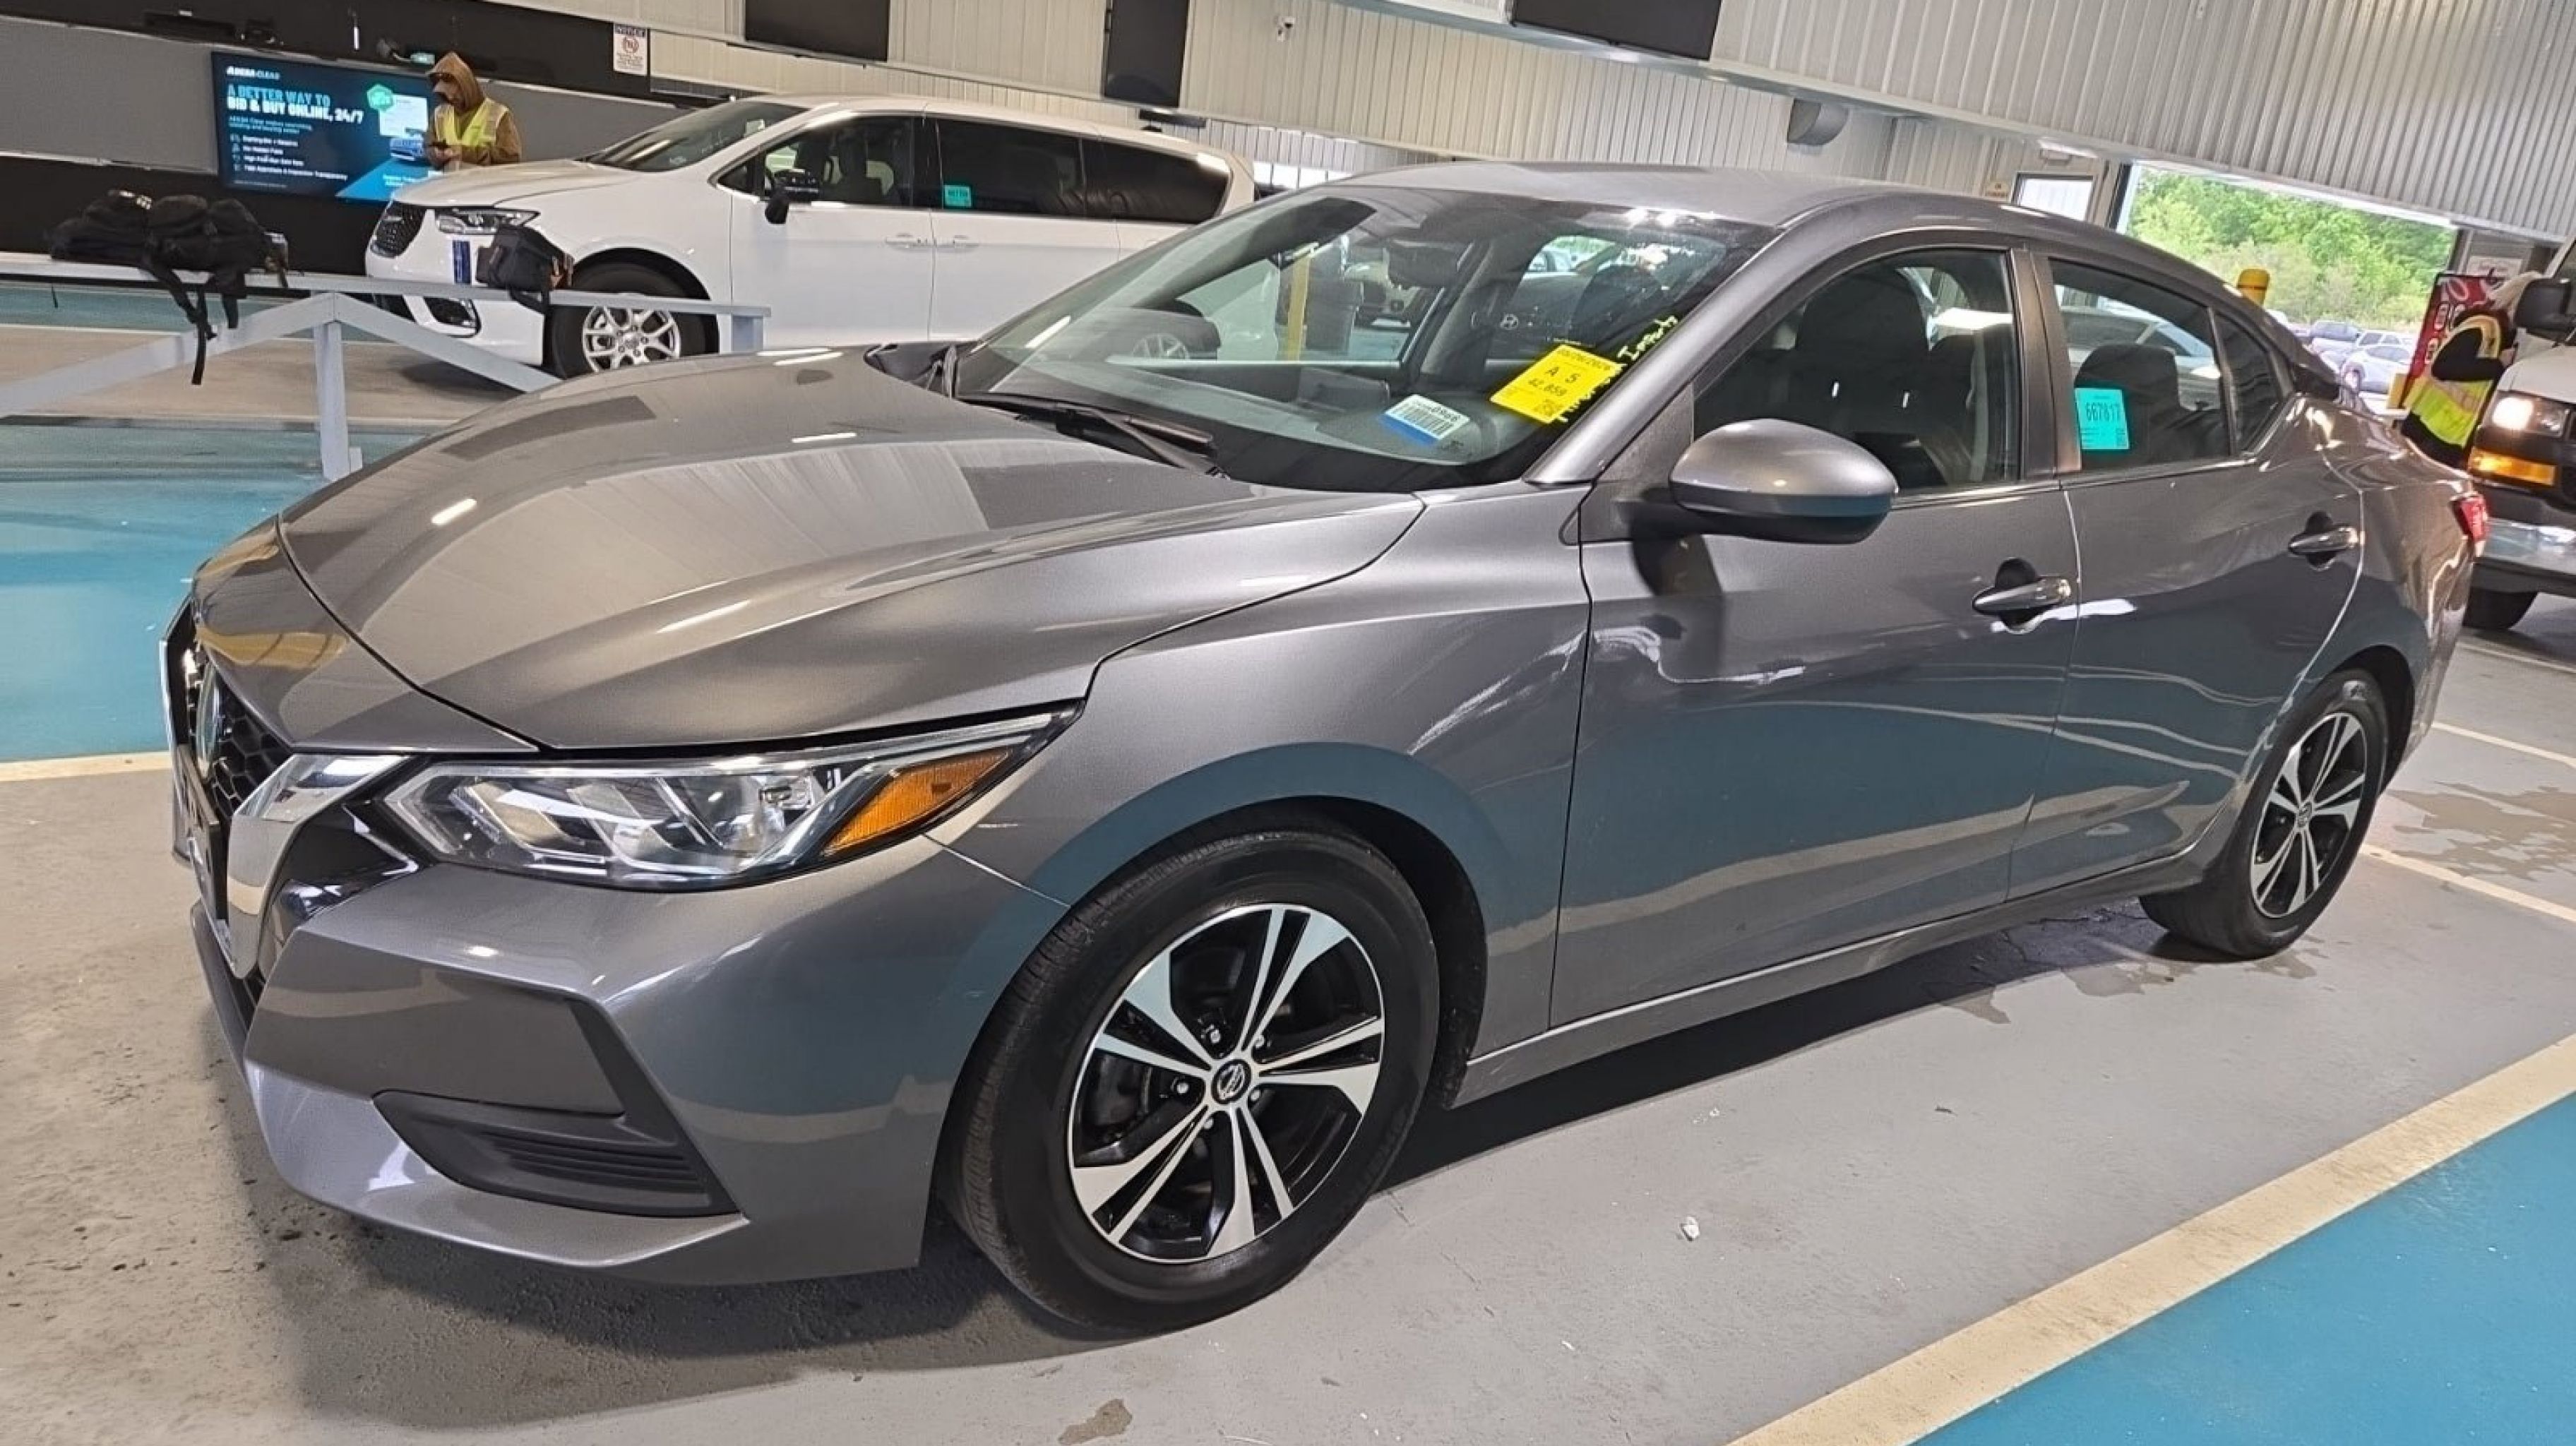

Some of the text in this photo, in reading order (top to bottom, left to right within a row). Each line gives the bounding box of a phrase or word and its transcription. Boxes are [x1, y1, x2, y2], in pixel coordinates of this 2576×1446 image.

[228, 84, 330, 107] A BETTER WAY TO
[227, 97, 246, 110] BID
[263, 101, 285, 114] BUY
[335, 108, 364, 124] 24/7
